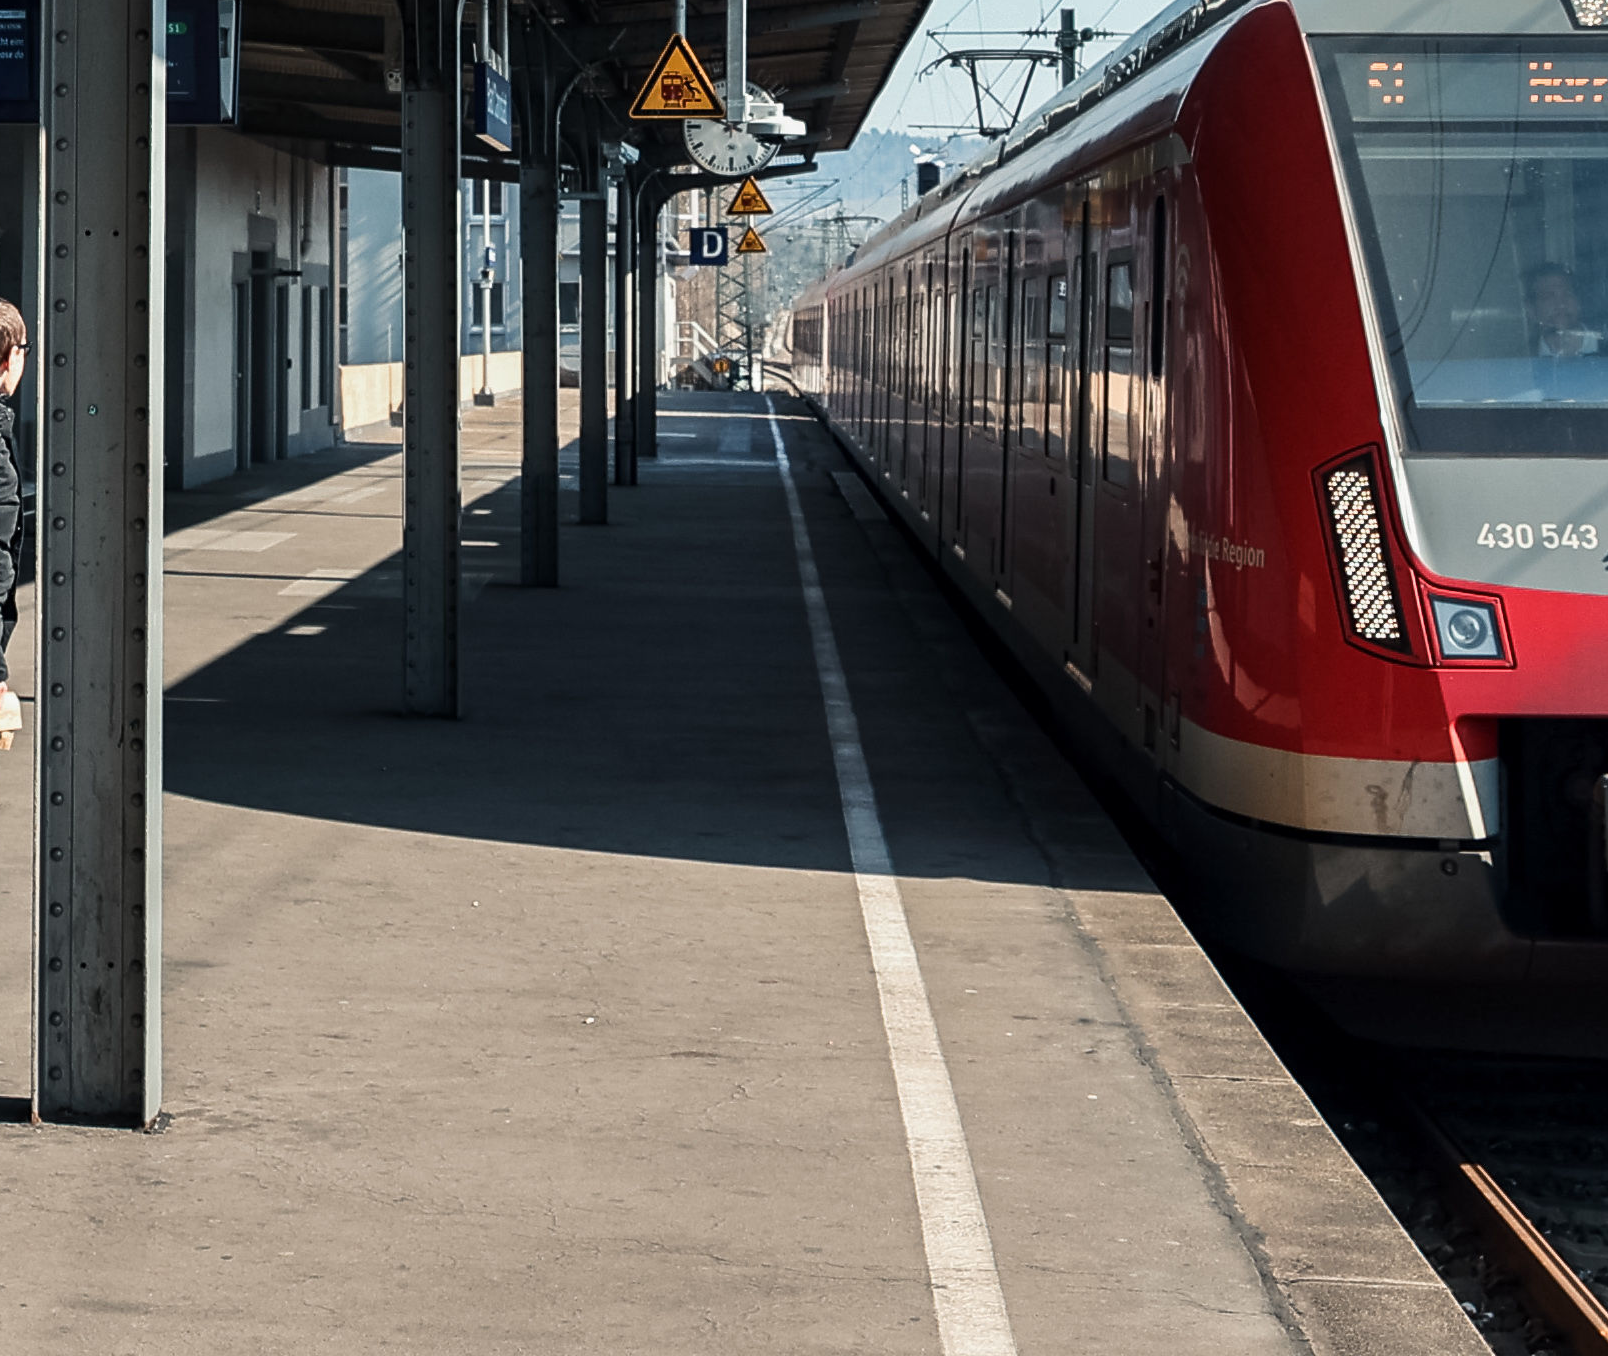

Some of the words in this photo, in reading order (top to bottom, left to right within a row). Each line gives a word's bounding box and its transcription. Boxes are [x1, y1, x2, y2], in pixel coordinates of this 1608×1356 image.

[702, 231, 723, 258] D
[1477, 523, 1533, 550] 430
[1543, 523, 1598, 550] 543
[1222, 536, 1265, 572] Region
